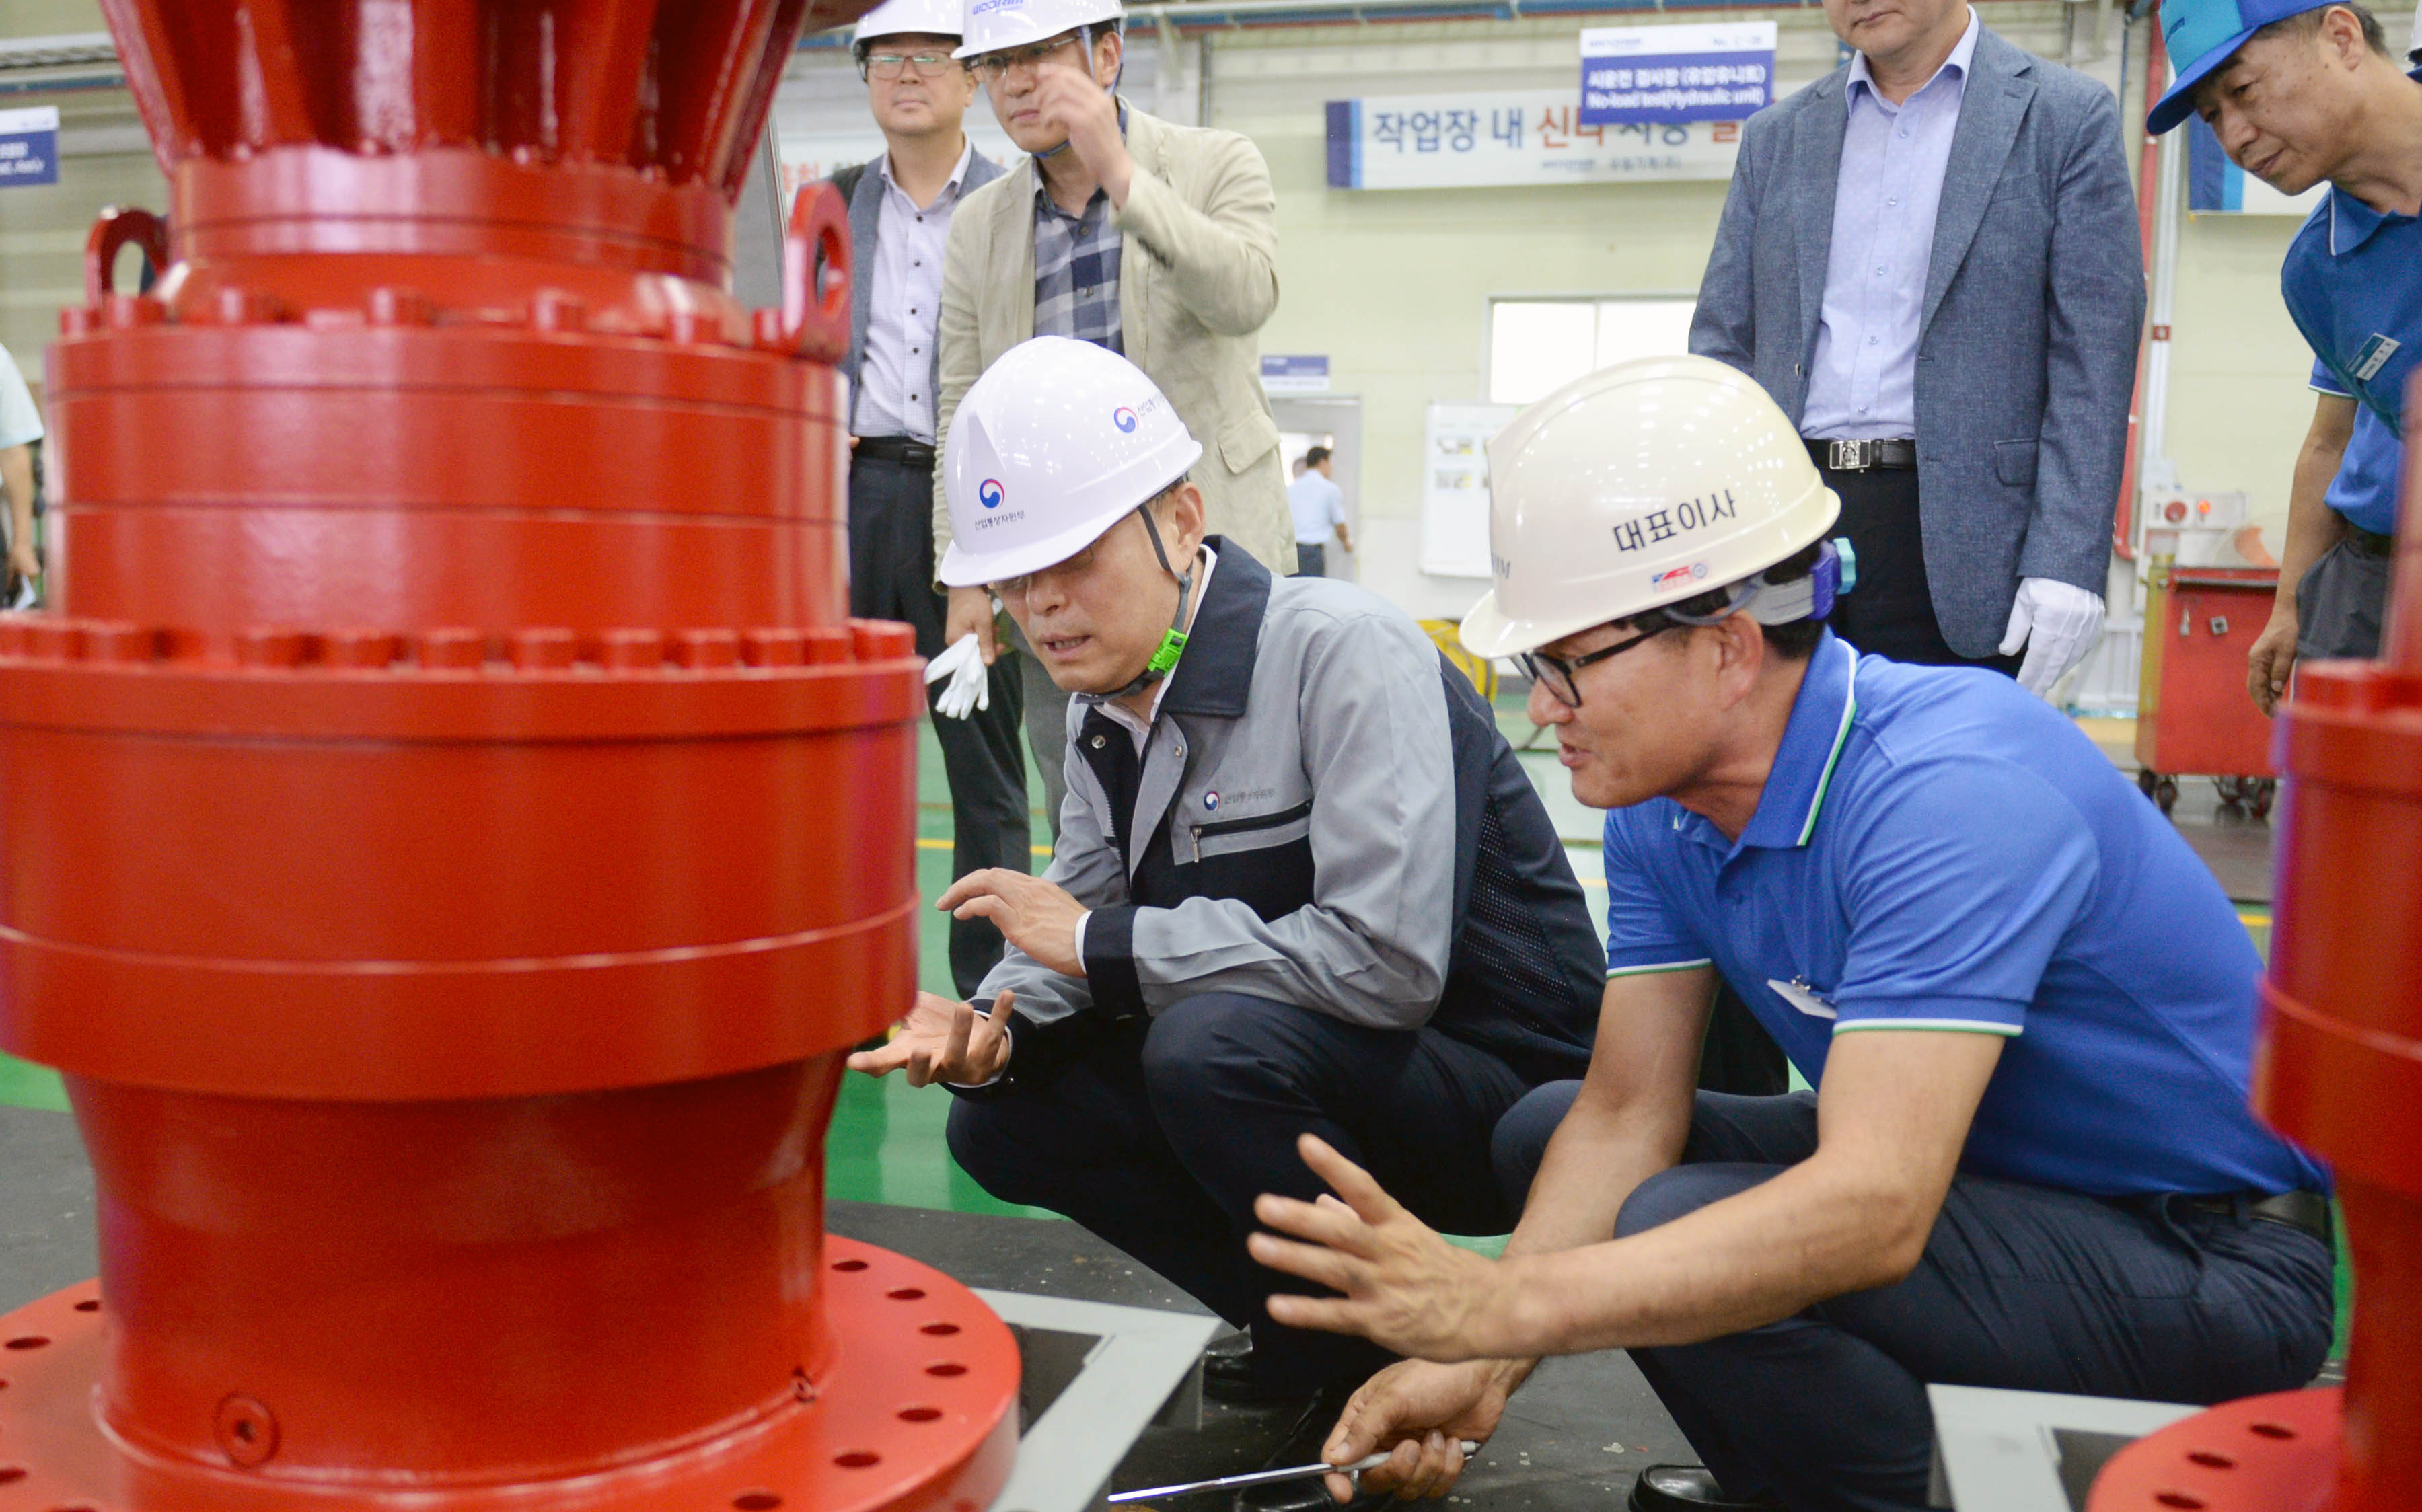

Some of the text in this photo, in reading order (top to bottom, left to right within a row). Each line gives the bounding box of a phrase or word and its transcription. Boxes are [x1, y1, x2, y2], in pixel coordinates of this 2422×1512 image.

[1374, 110, 1479, 153] 작업장
[1492, 107, 1523, 149] 내
[1613, 488, 1737, 552] 대표이사
